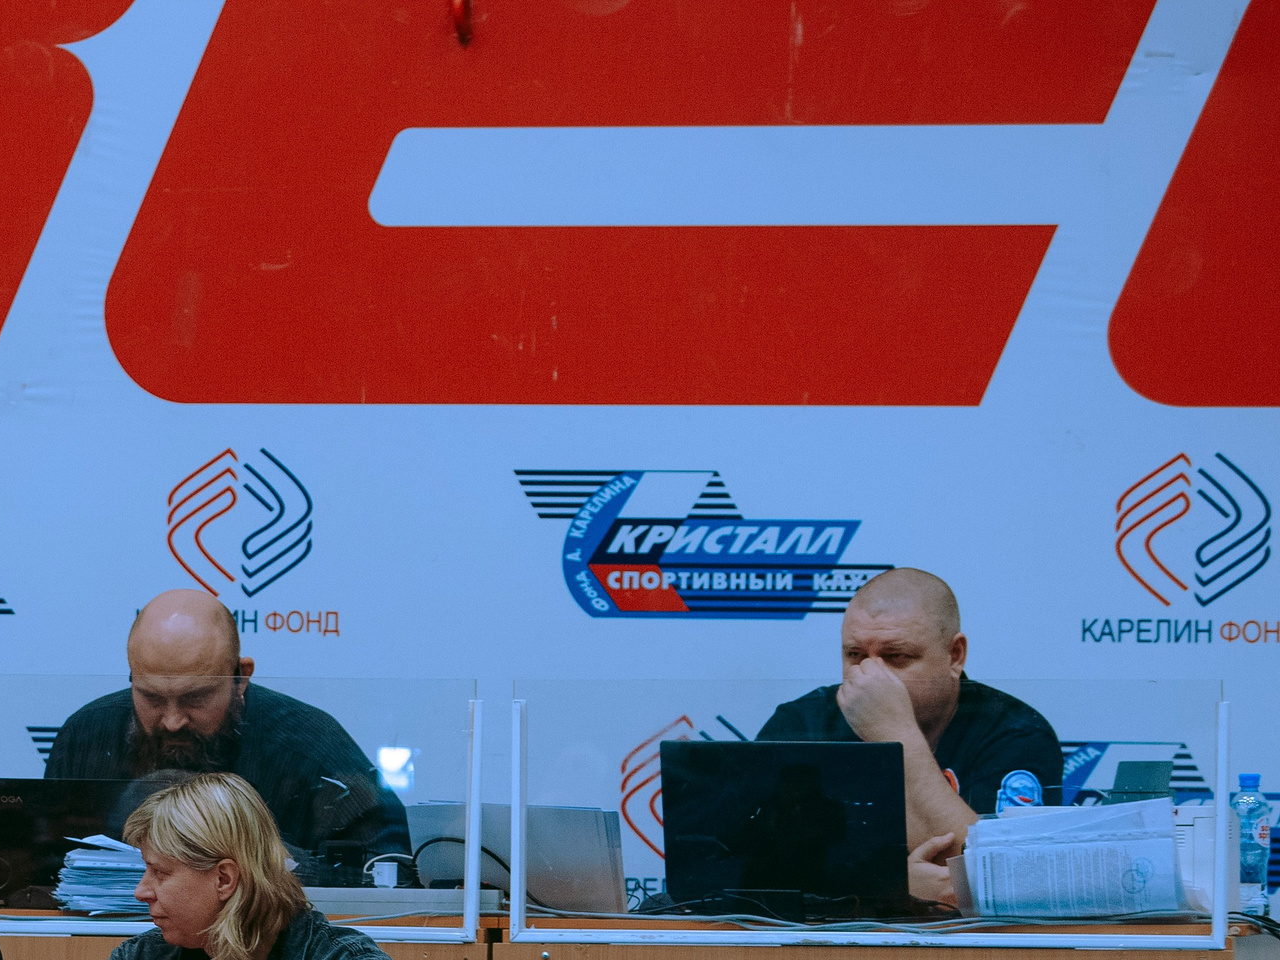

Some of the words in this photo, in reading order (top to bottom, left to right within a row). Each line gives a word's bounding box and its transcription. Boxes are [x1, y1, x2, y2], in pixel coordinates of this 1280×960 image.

[606, 524, 847, 555] КРИСТАЛЛ
[607, 569, 793, 591] СПОРТИВНЫЙ
[813, 572, 869, 591] КЛУ
[265, 610, 340, 637] ФОНД
[1081, 618, 1213, 643] КАРЕЛИН
[1220, 619, 1280, 644] ФОН
